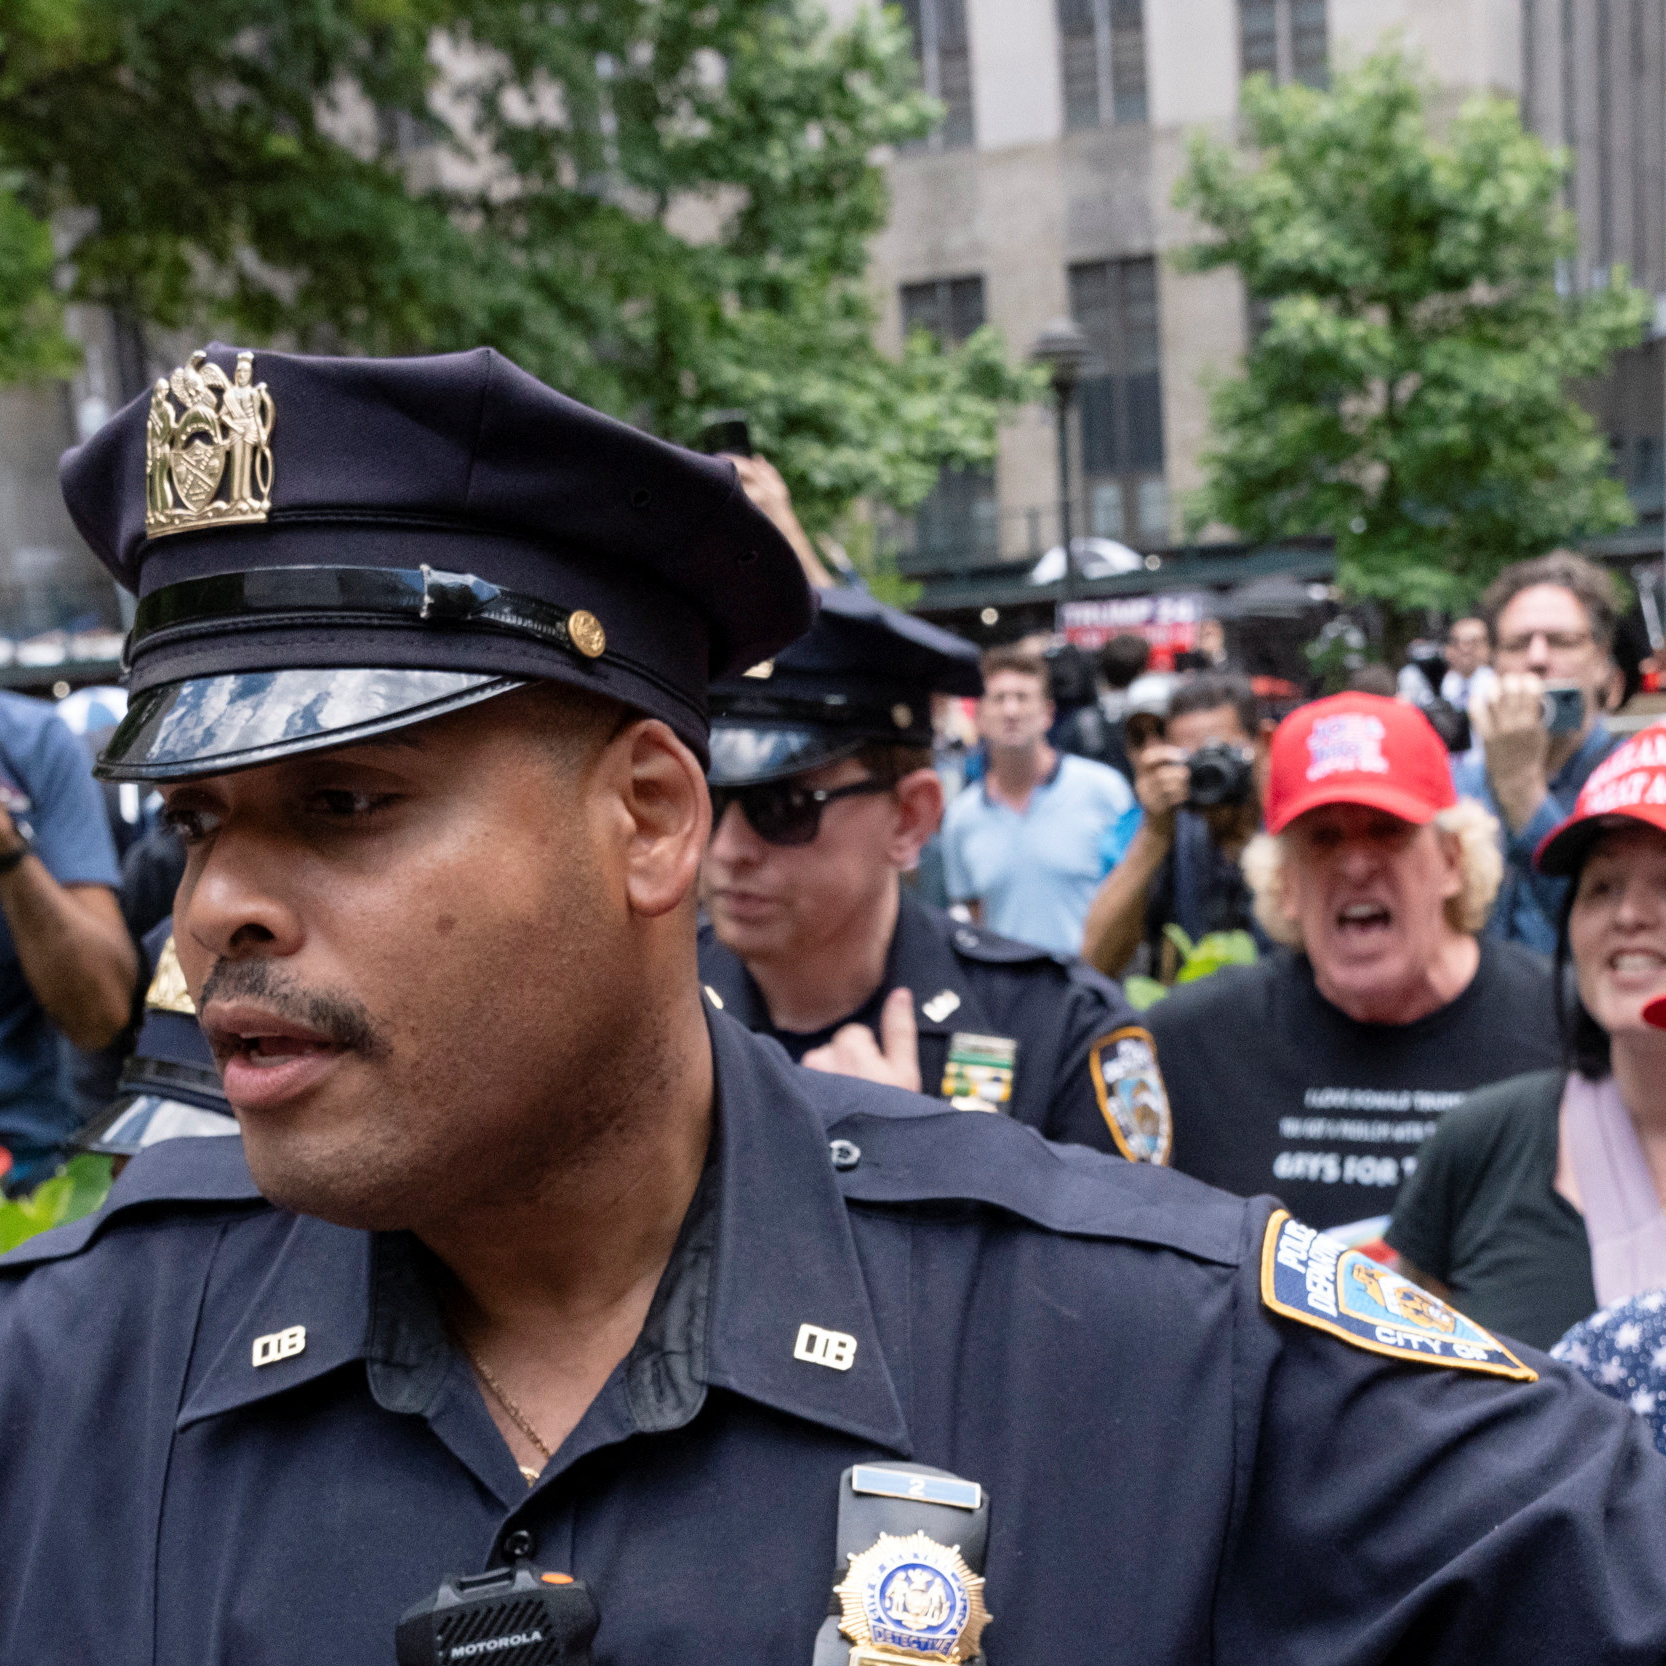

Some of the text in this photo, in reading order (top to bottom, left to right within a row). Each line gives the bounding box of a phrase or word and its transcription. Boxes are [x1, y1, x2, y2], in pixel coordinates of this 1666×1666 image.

[1343, 1155, 1400, 1187] FOR
[1375, 1325, 1442, 1355] CITY
[908, 1478, 926, 1497] 2
[451, 1630, 543, 1659] MOTOROLA
[874, 1625, 955, 1656] DETECTIVE
